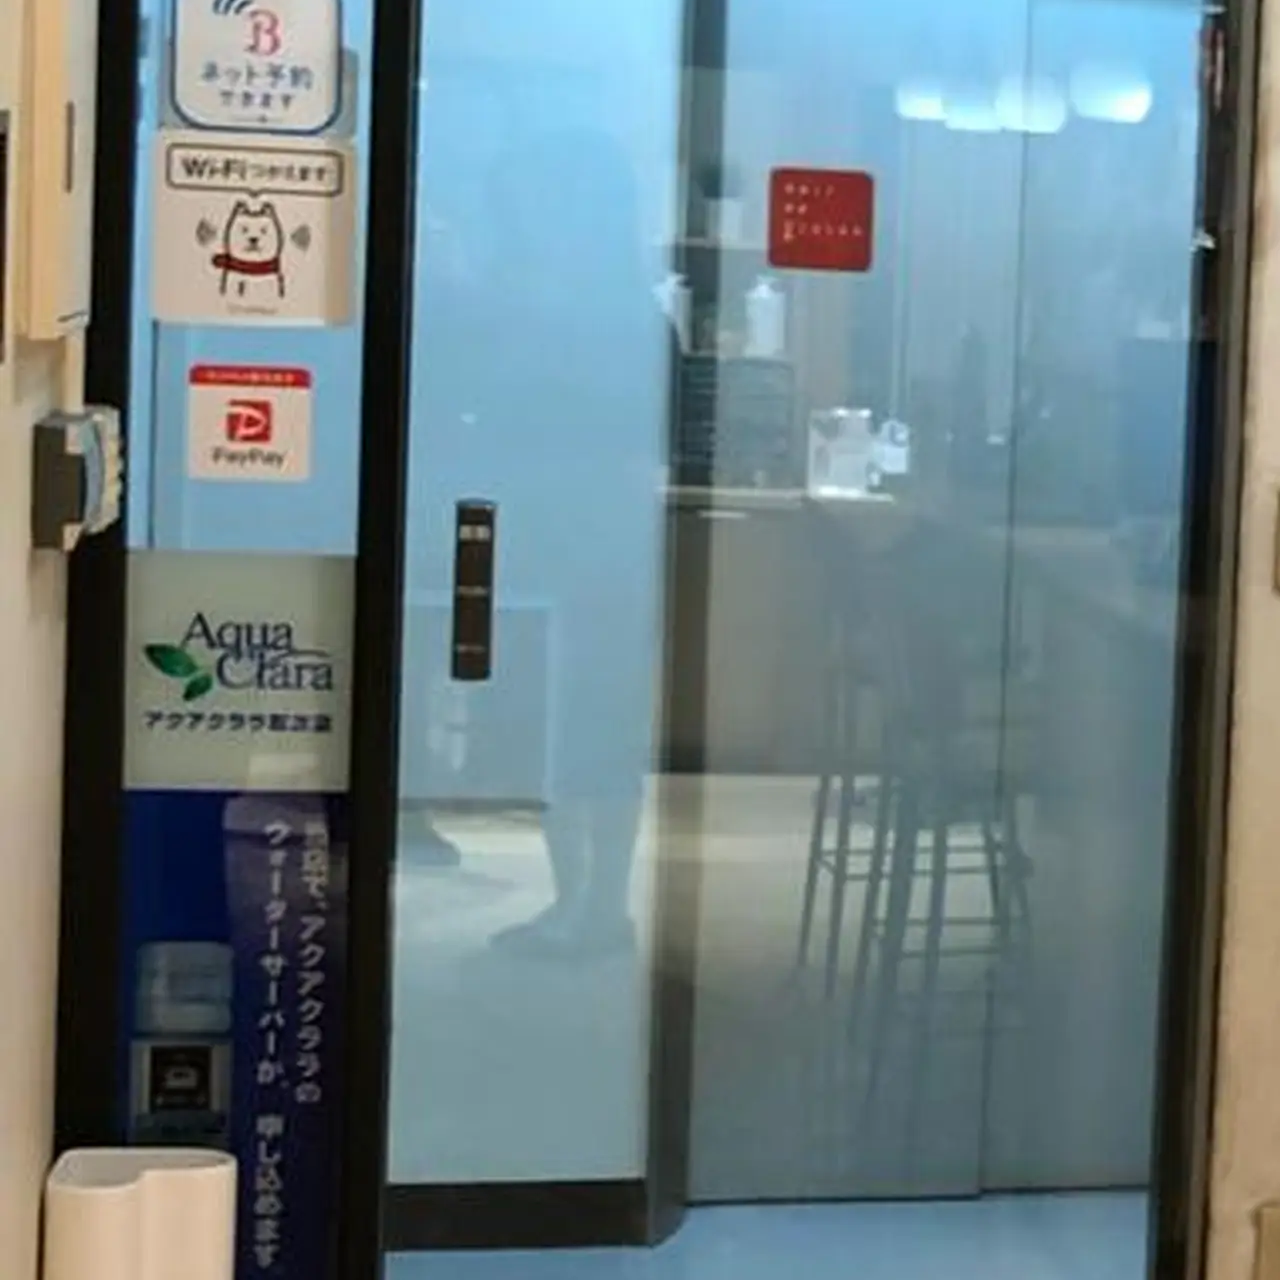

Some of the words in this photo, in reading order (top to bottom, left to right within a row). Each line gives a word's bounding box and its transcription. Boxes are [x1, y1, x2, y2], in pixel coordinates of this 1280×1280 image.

[211, 445, 285, 468] PayPay
[180, 611, 294, 660] Aqua
[215, 650, 334, 692] Clara
